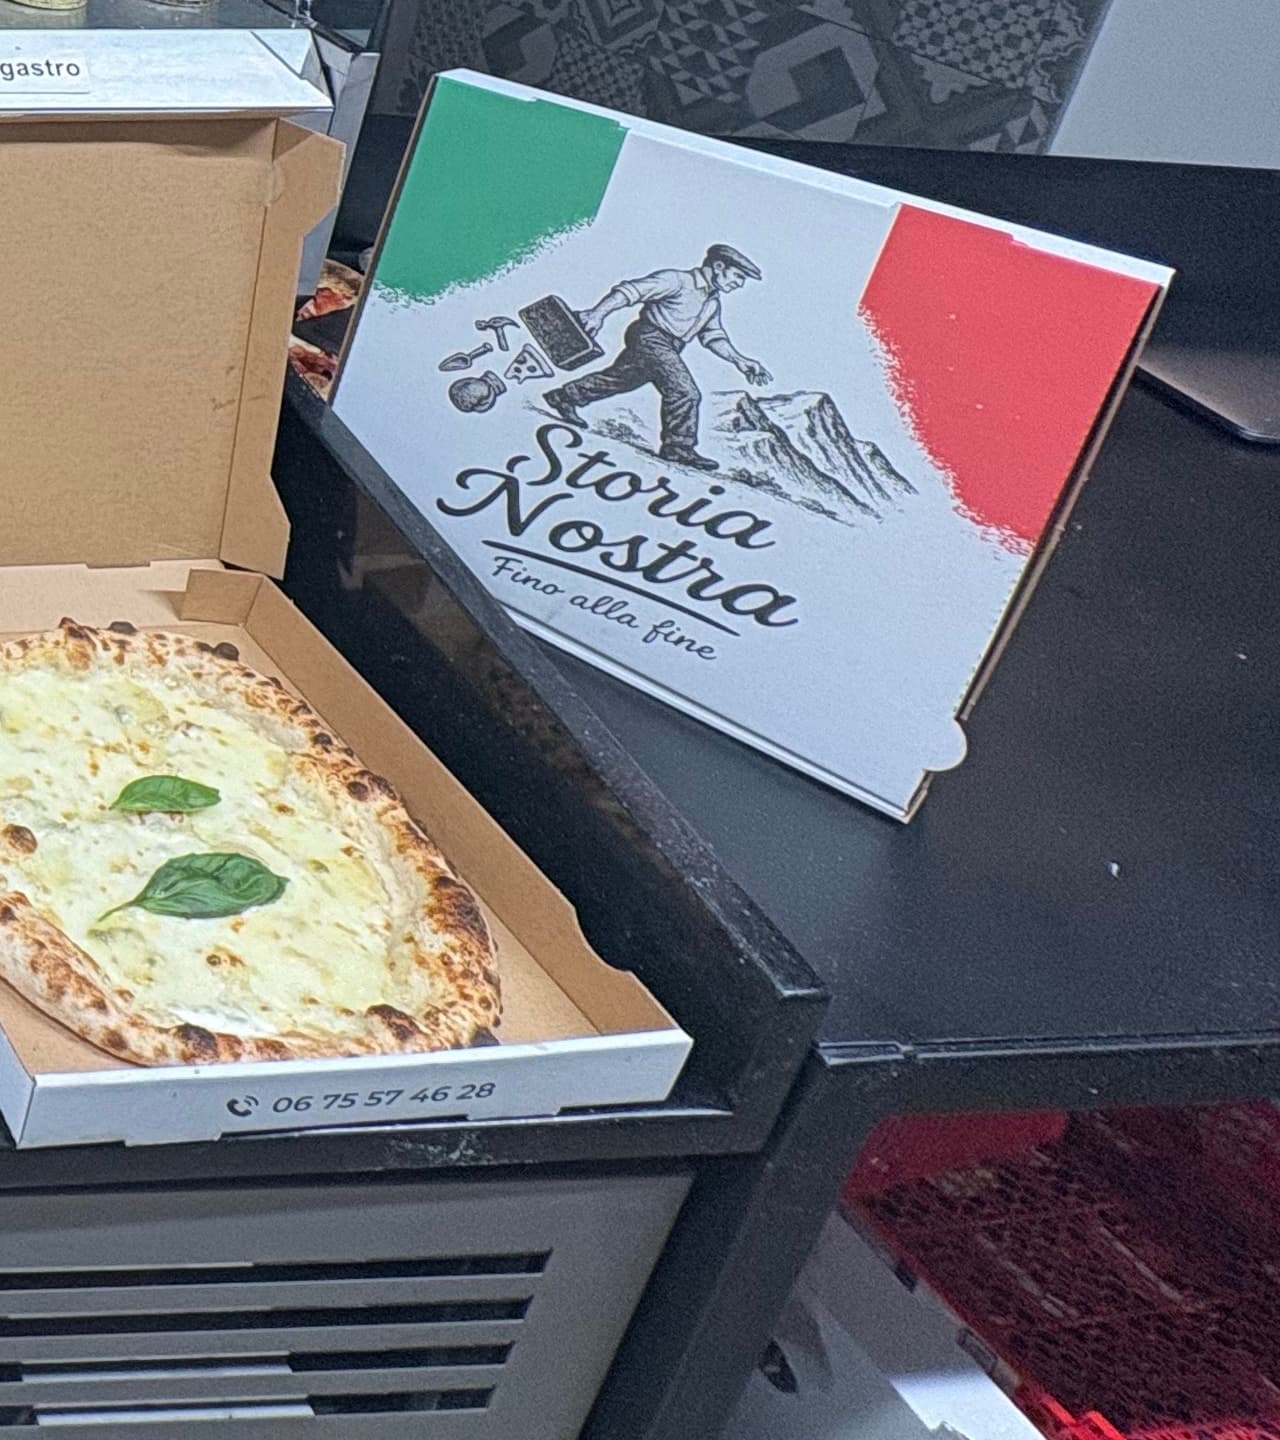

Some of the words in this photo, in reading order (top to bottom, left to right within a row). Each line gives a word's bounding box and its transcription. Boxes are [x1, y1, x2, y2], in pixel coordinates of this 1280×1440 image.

[505, 423, 777, 549] Storia
[436, 468, 799, 628] Nostra
[492, 555, 564, 596] Fino
[570, 596, 640, 629] alla
[642, 619, 717, 661] fine
[272, 1095, 313, 1113] 06
[323, 1093, 358, 1109] 75
[364, 1089, 404, 1106] 57
[409, 1085, 451, 1103] 46
[455, 1082, 496, 1099] 28
